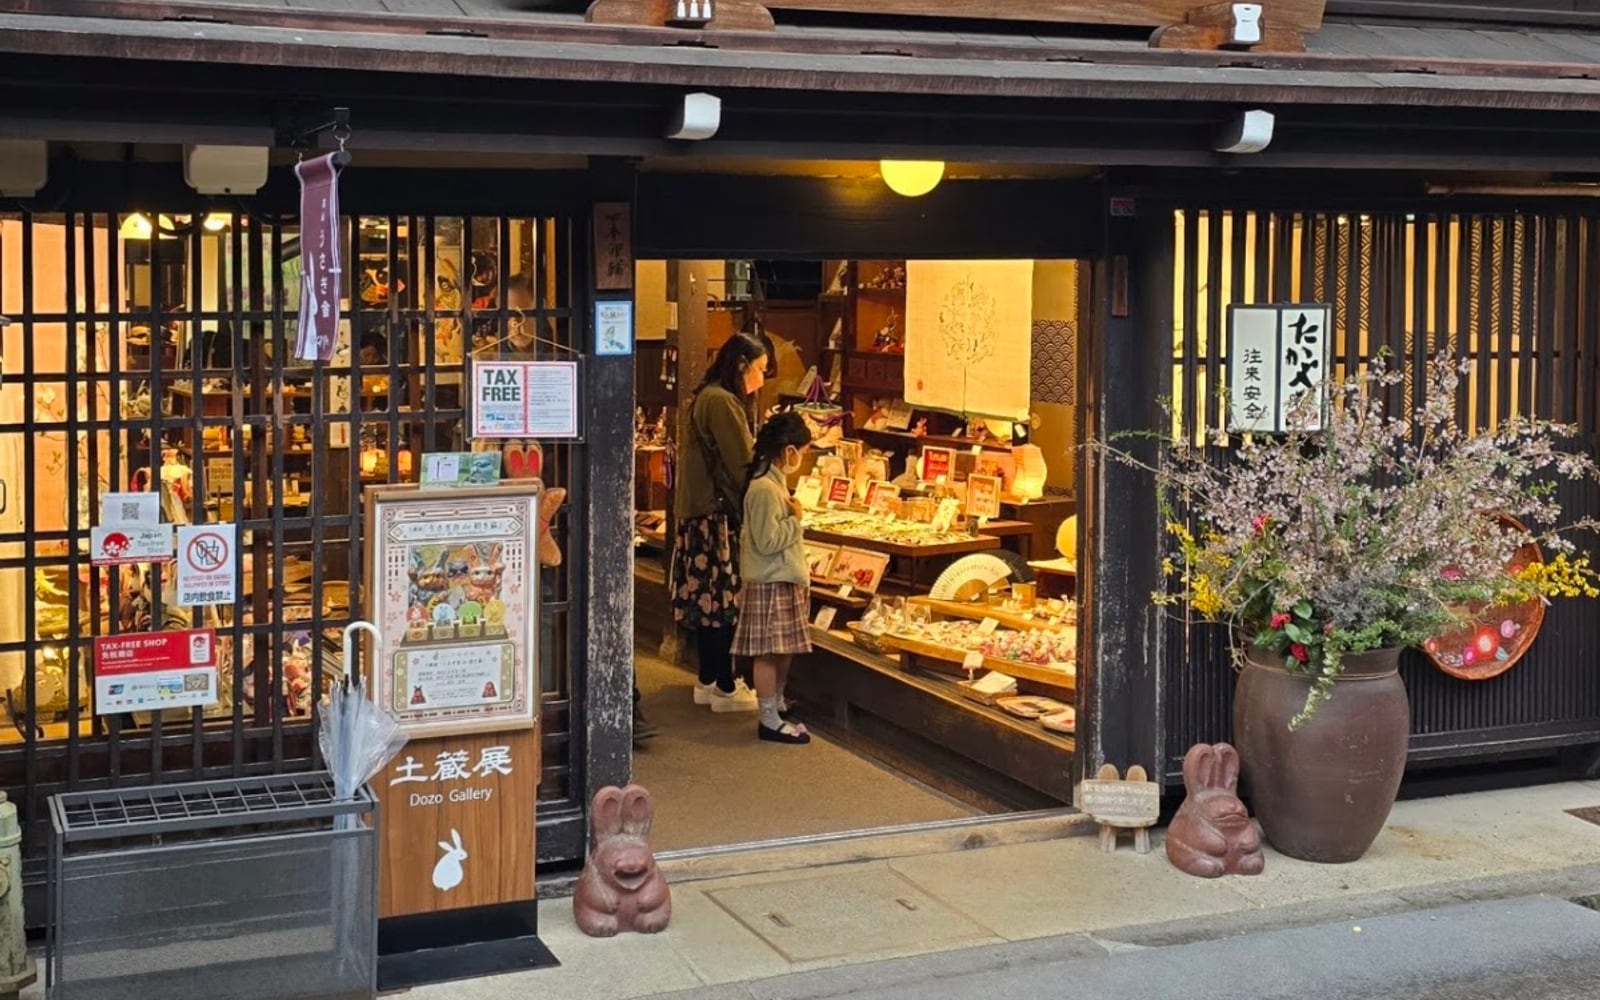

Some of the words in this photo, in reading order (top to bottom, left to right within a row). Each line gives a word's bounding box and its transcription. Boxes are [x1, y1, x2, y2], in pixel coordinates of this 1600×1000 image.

[483, 369, 518, 385] TAX
[482, 386, 521, 401] FREE
[100, 640, 141, 651] TAX-FREE
[144, 638, 168, 648] SHOP
[390, 746, 513, 786] 土蔵展
[410, 793, 443, 807] Dozo
[449, 787, 493, 802] Gallery
